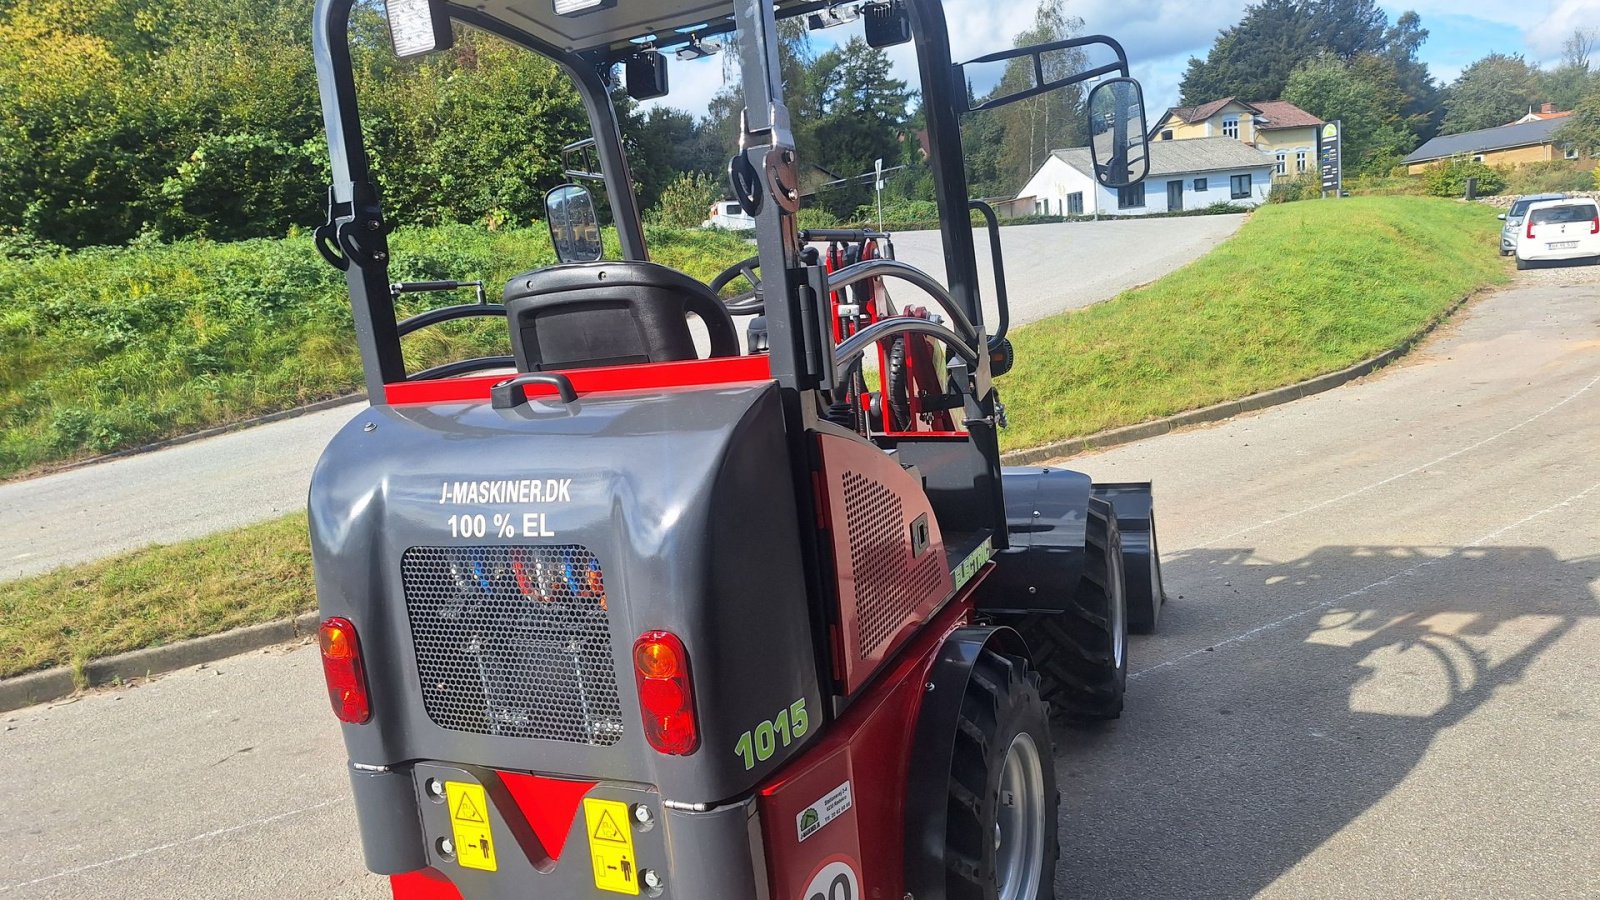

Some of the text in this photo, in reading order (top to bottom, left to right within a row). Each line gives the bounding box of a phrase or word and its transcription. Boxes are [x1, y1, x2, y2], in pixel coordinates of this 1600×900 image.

[439, 479, 572, 504] J-MASKINER.DK
[448, 512, 555, 538] 100 % EL
[954, 538, 990, 591] ELECTRIC
[734, 697, 809, 770] 1015
[810, 873, 852, 900] 0
